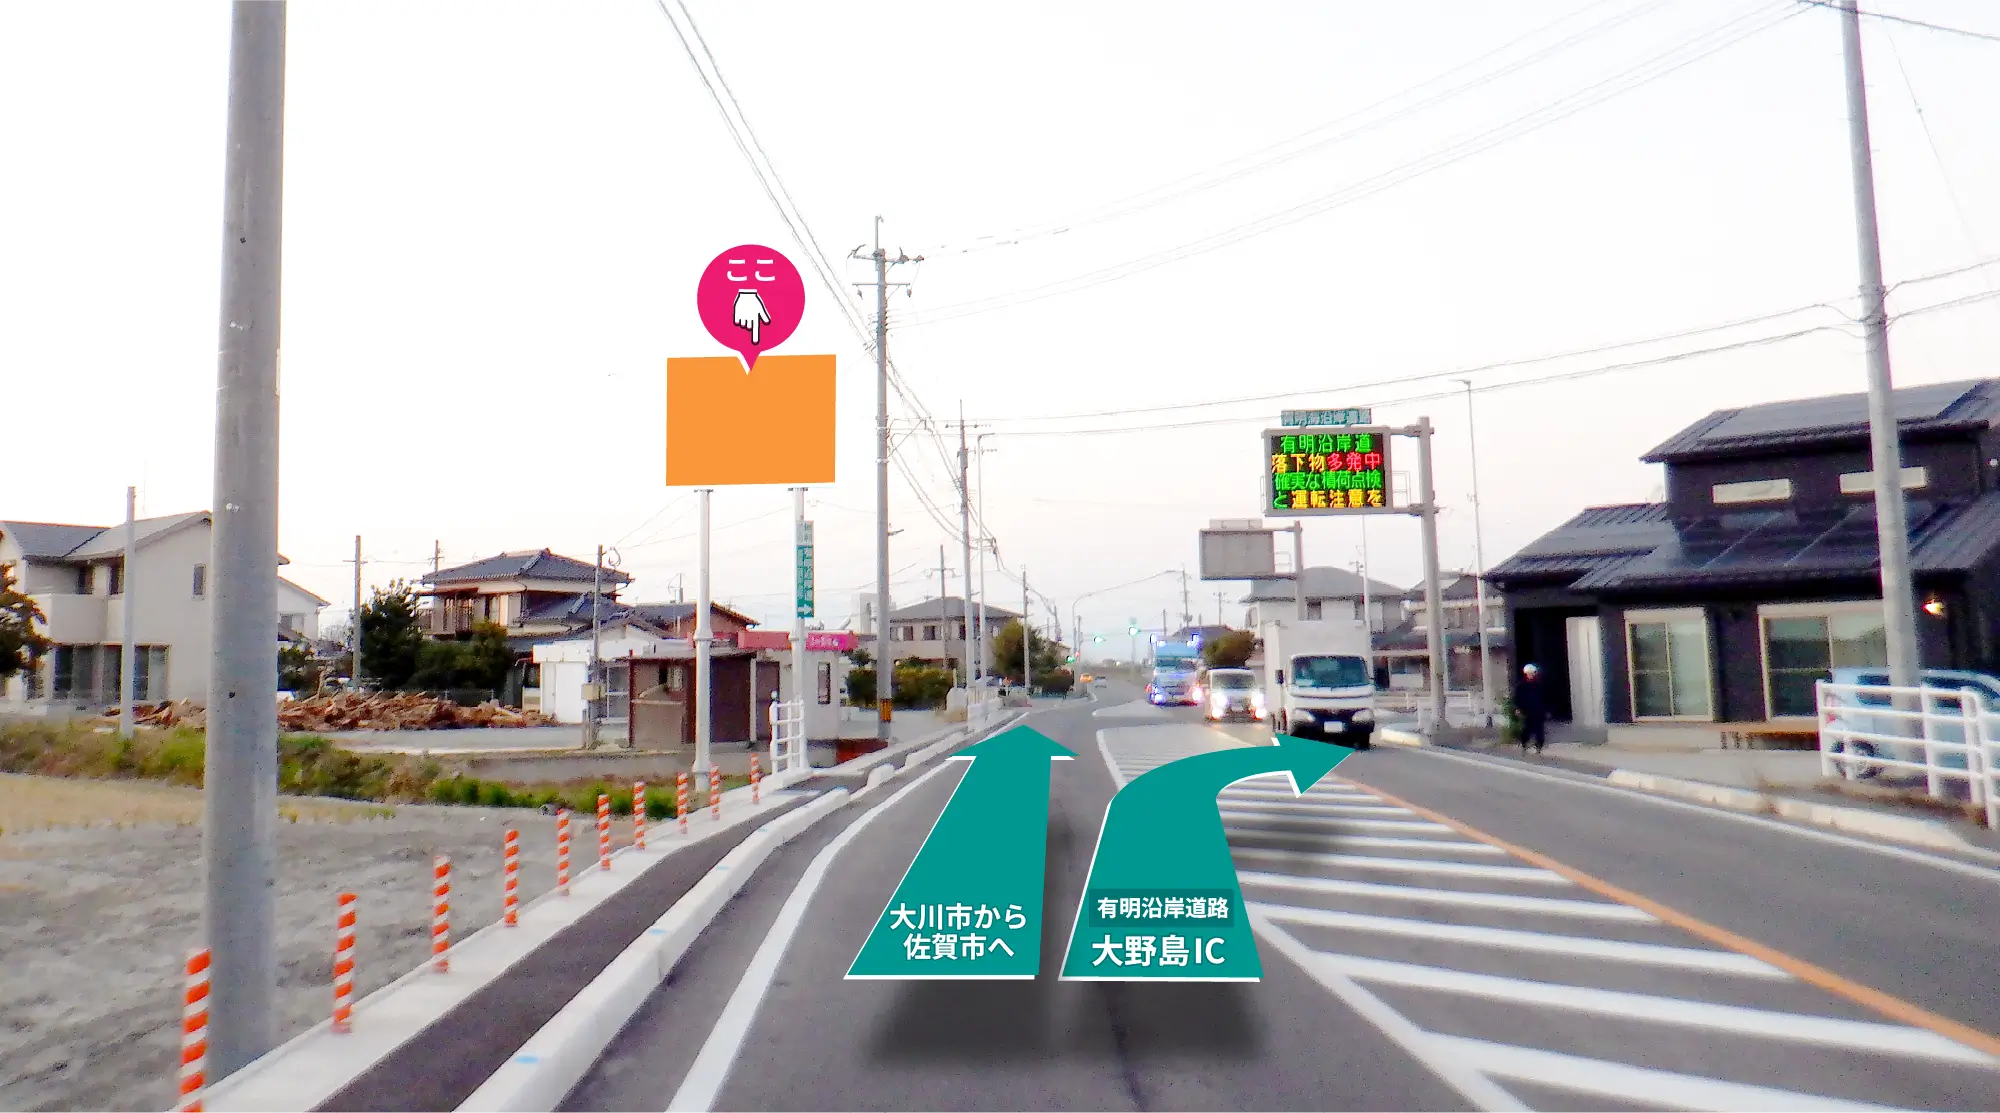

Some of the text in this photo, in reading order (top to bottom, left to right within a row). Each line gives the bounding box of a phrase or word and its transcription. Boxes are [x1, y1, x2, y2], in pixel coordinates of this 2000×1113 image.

[1280, 433, 1372, 453] 有明沿岸道
[1272, 452, 1382, 473] 落下物多発中
[1275, 470, 1382, 490] 確実な積荷点検
[1273, 489, 1383, 509] と運転注意を
